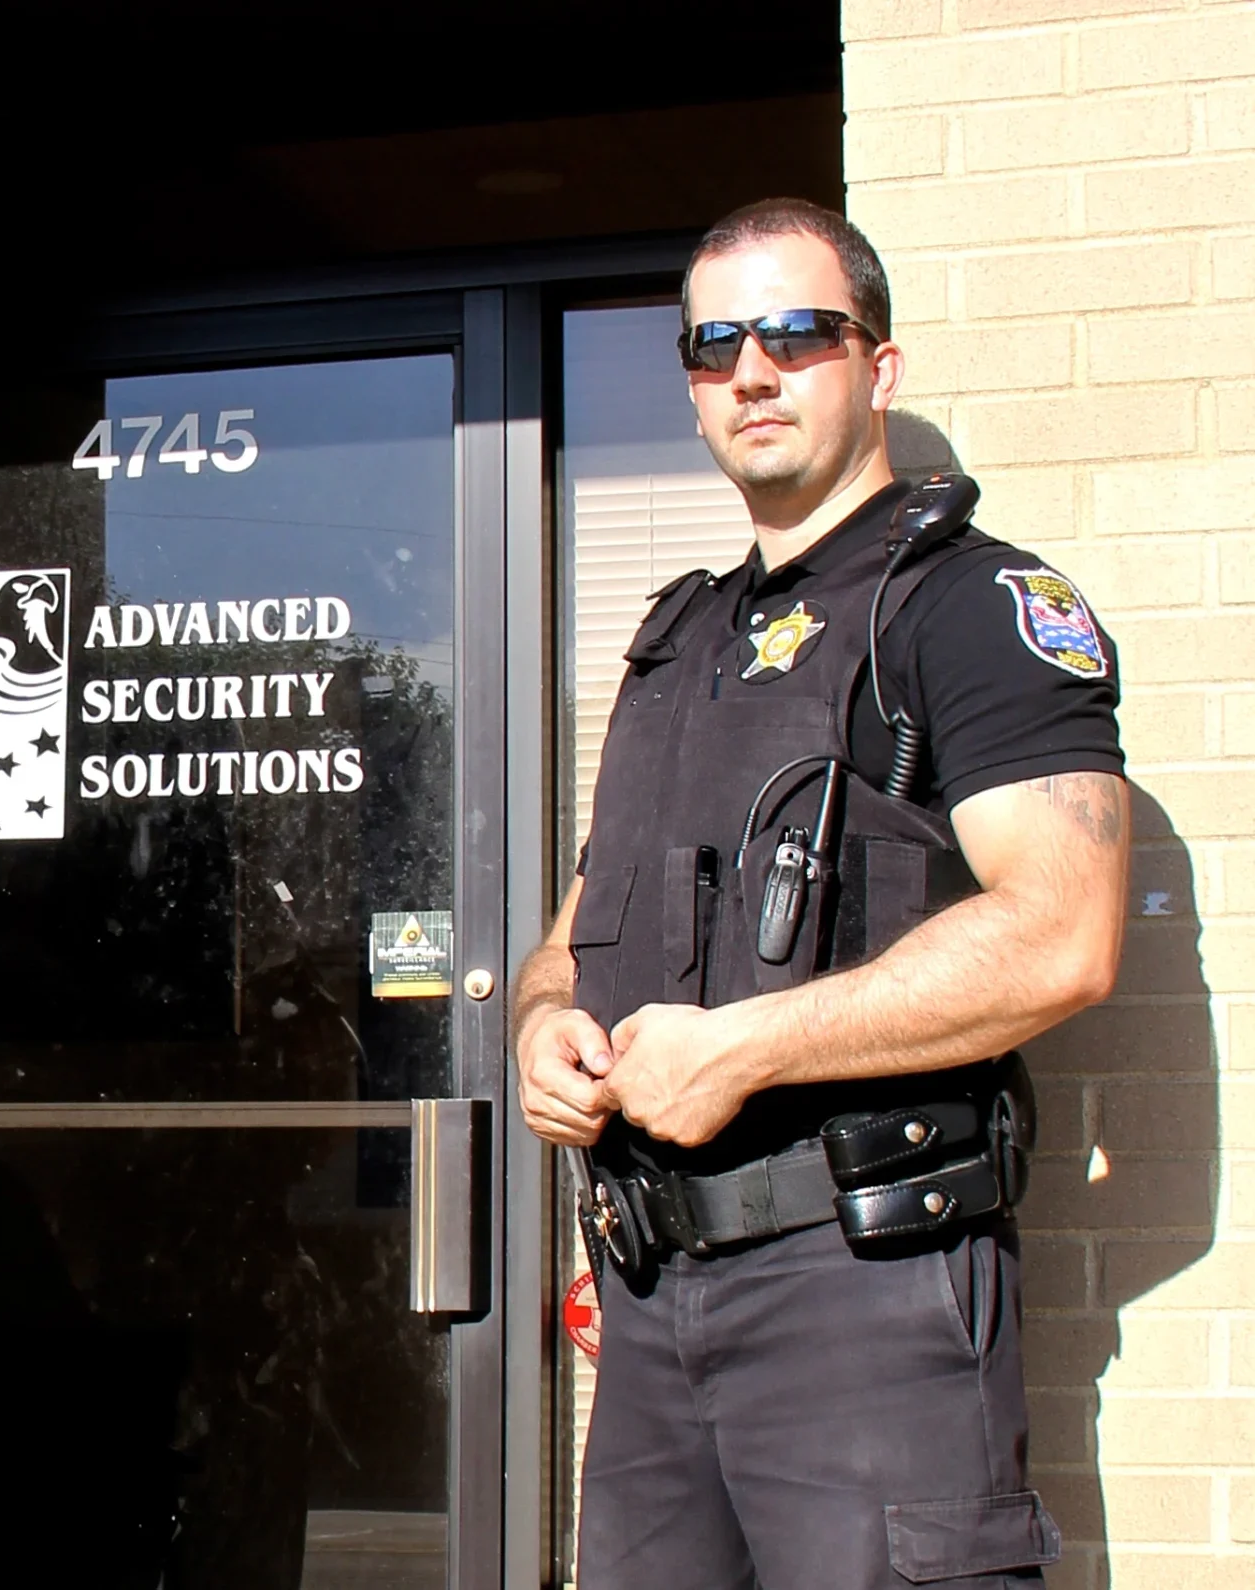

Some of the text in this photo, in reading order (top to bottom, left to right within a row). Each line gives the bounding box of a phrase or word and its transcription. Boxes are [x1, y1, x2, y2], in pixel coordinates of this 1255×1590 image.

[72, 408, 259, 480] 4745
[84, 597, 351, 649] ADVANCED
[81, 672, 335, 724] SECURITY
[80, 748, 364, 799] SOLUTIONS
